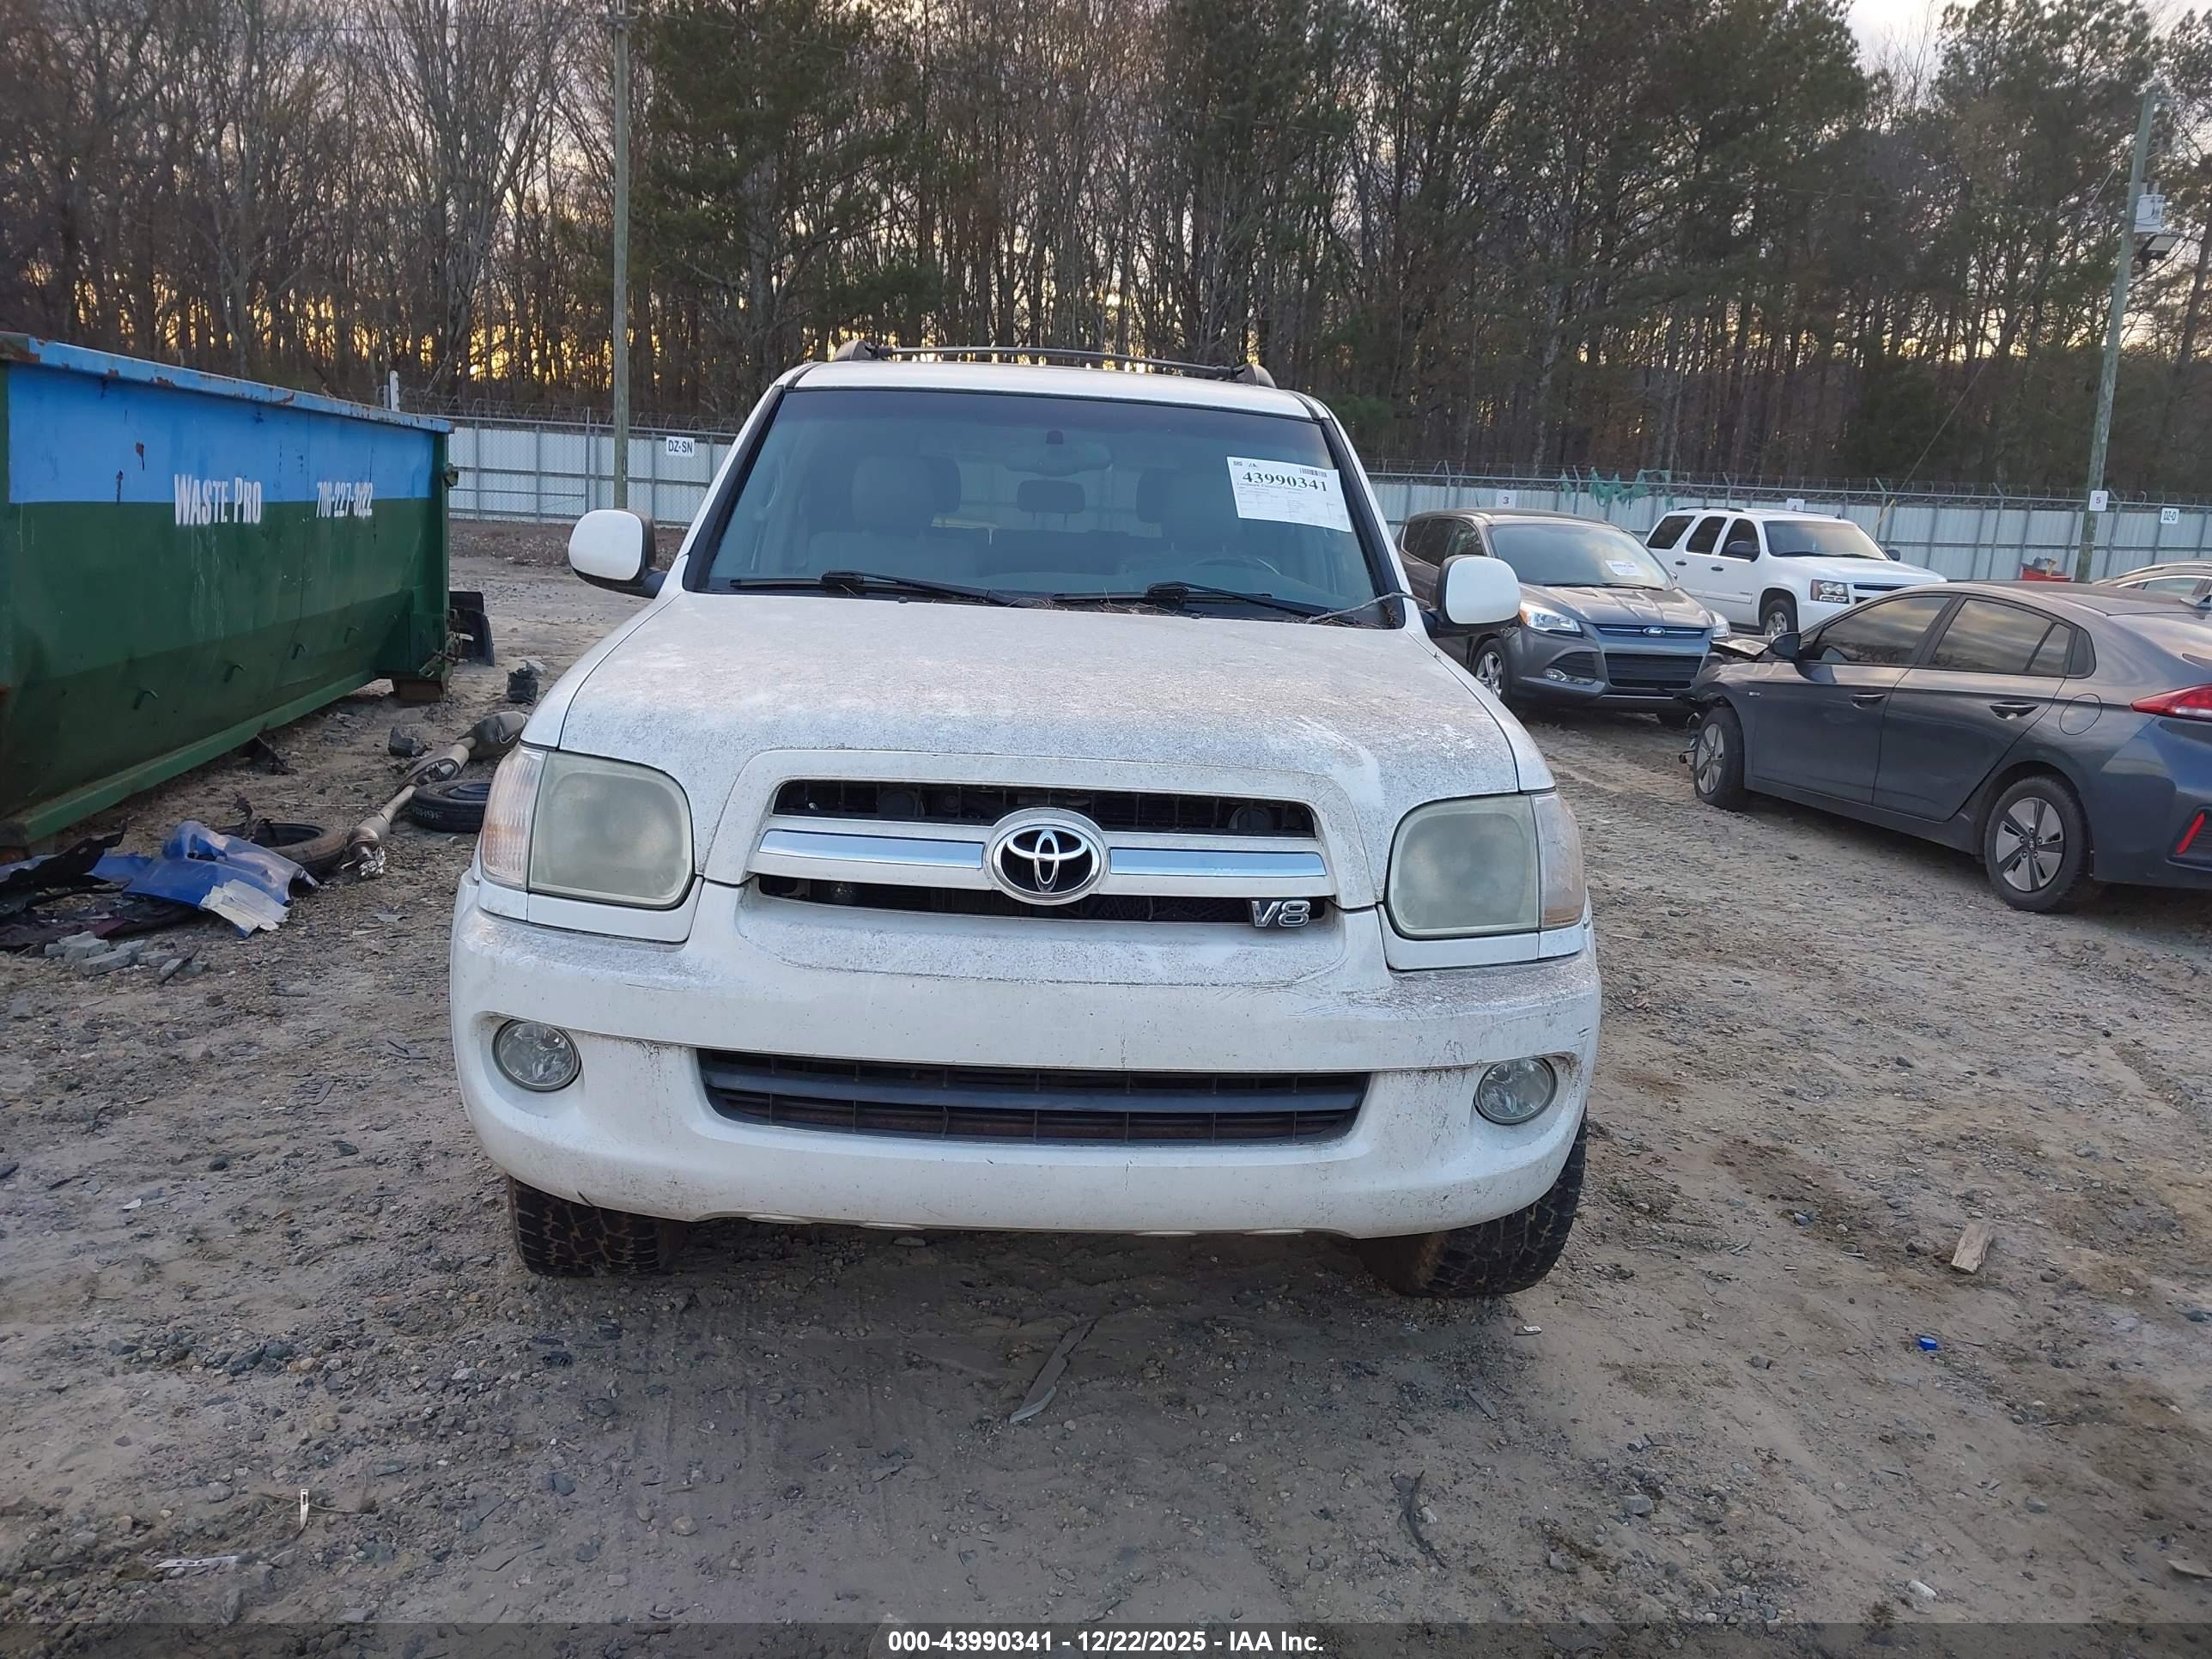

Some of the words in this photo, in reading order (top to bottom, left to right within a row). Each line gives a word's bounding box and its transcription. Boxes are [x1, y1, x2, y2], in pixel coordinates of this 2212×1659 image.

[668, 440, 693, 453] DZ-SN
[1243, 471, 1327, 492] 43990341
[1503, 496, 1510, 505] 3
[1251, 900, 1311, 927] V8
